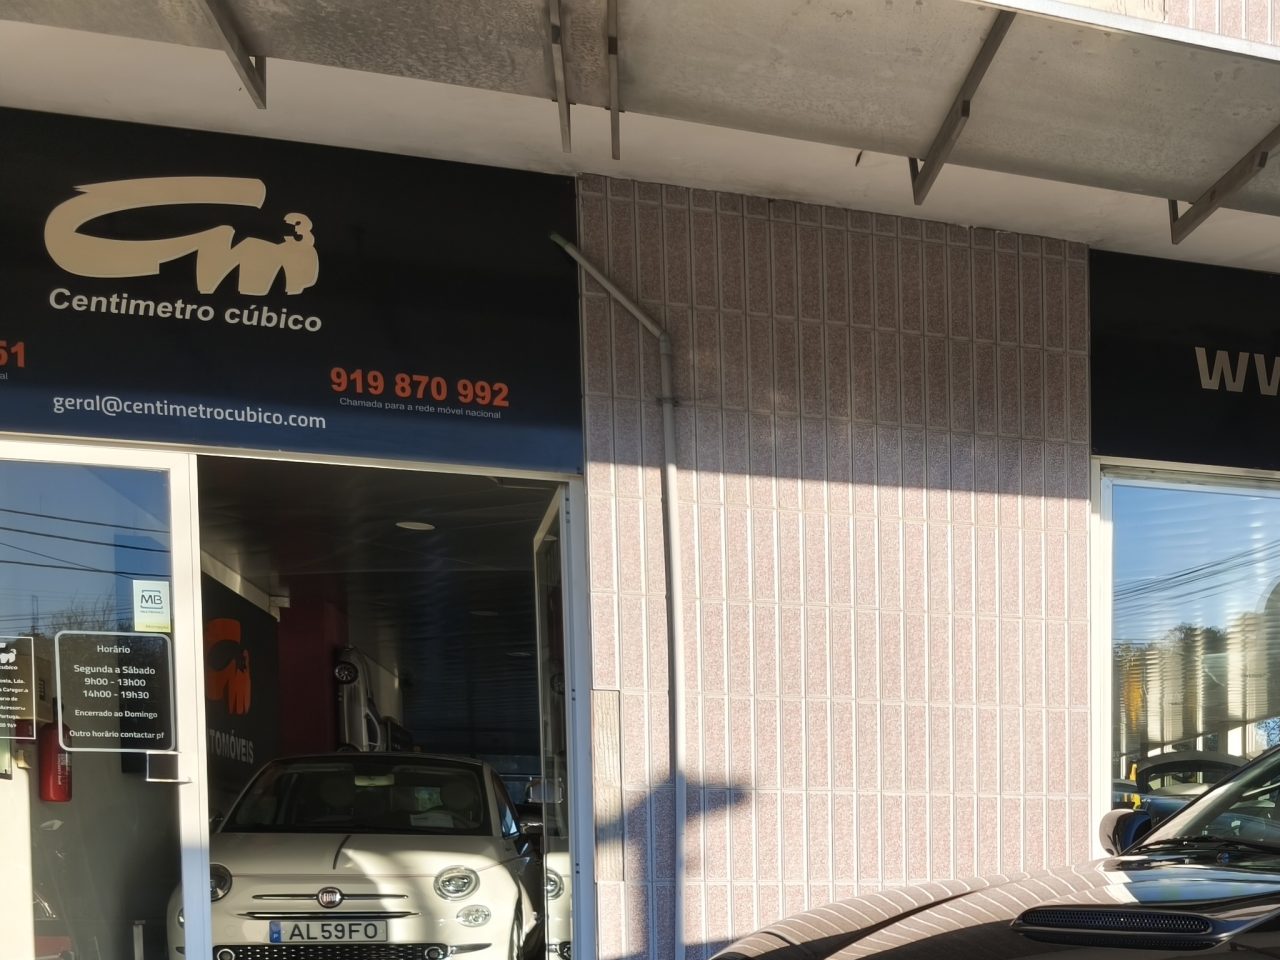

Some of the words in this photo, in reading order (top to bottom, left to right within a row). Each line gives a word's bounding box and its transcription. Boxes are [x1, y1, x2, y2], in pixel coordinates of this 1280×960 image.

[49, 288, 215, 321] Centimetro
[224, 305, 322, 332] cúbico
[330, 367, 385, 395] 919
[394, 373, 448, 401] 870
[457, 379, 510, 407] 992
[53, 395, 326, 429] geral@centimetrocubico.com
[339, 397, 383, 409] Chamada
[385, 402, 405, 411] para
[415, 403, 435, 413] rede
[437, 404, 464, 416] móvel
[466, 409, 501, 419] nacional
[141, 594, 163, 605] MB
[73, 664, 113, 675] Segunda
[122, 665, 156, 675] Sábado
[84, 677, 108, 686] 9h00
[117, 678, 146, 687] 13h00
[83, 690, 112, 698] 14h00
[121, 691, 150, 699] 19h30
[74, 709, 113, 717] Encerrado
[124, 710, 158, 720] Domingo
[120, 731, 155, 739] contactar
